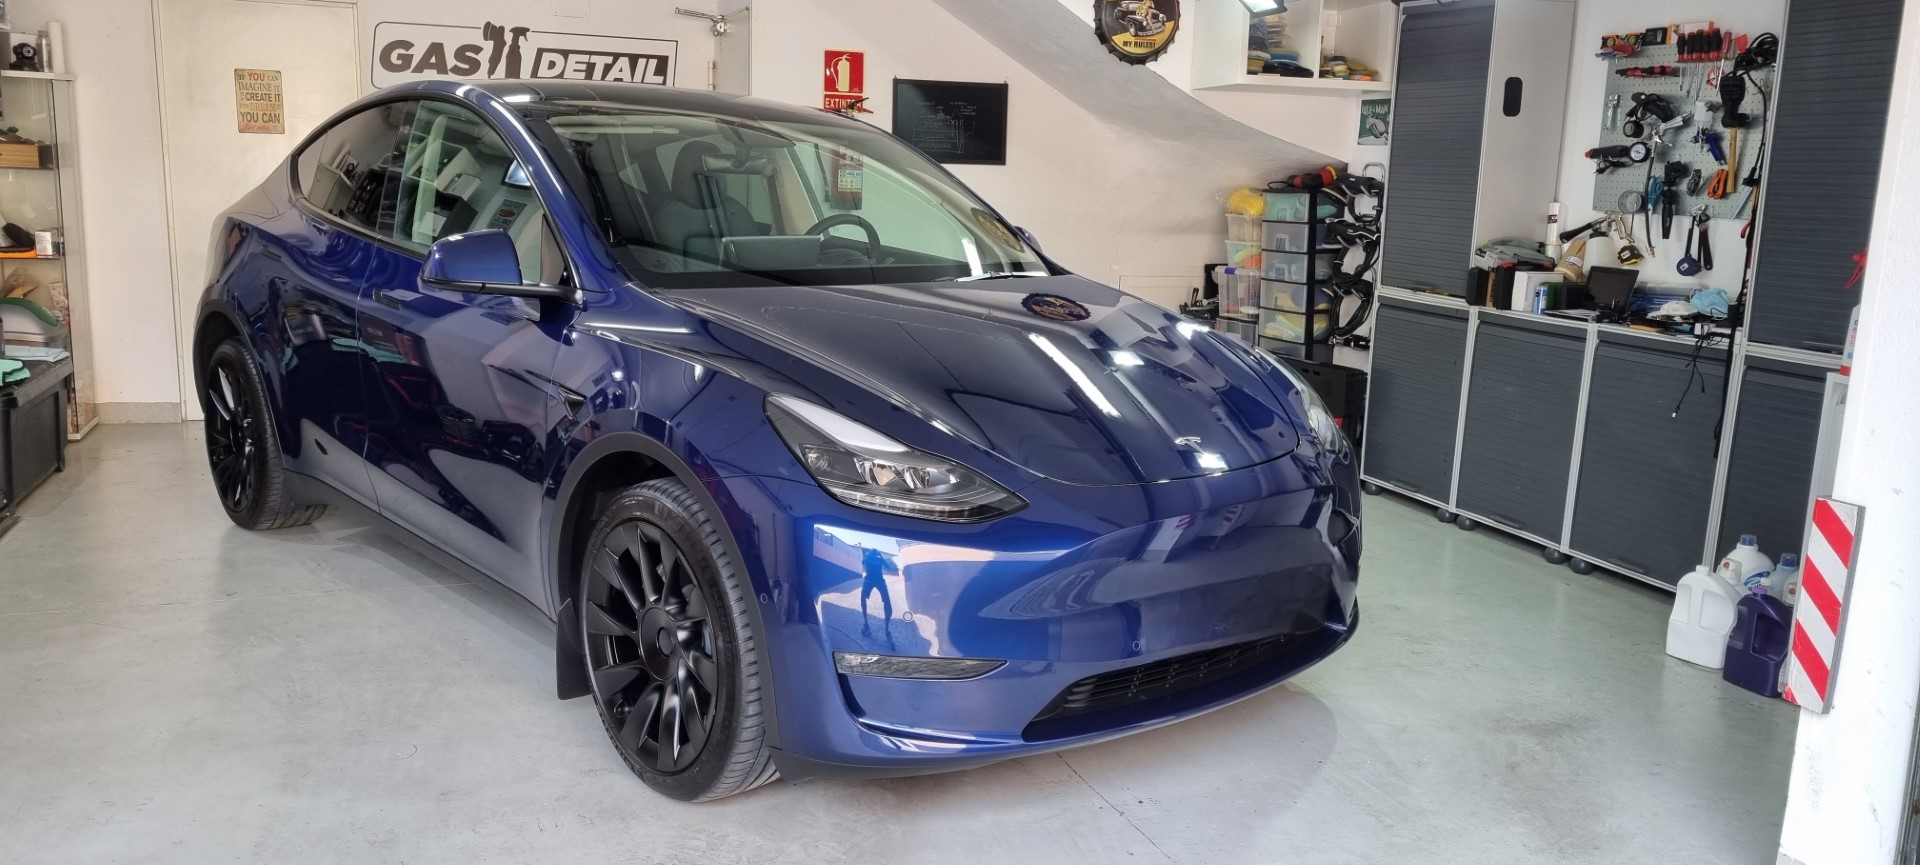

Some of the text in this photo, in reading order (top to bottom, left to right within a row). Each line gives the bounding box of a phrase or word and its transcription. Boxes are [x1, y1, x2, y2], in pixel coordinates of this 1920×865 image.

[1122, 40, 1132, 48] MY
[379, 39, 665, 84] GAS DETAIL
[248, 72, 265, 81] YOU
[239, 82, 272, 91] IMAGINE
[245, 92, 272, 102] CREATE
[274, 93, 281, 102] IT
[240, 111, 280, 124] YOU CAN
